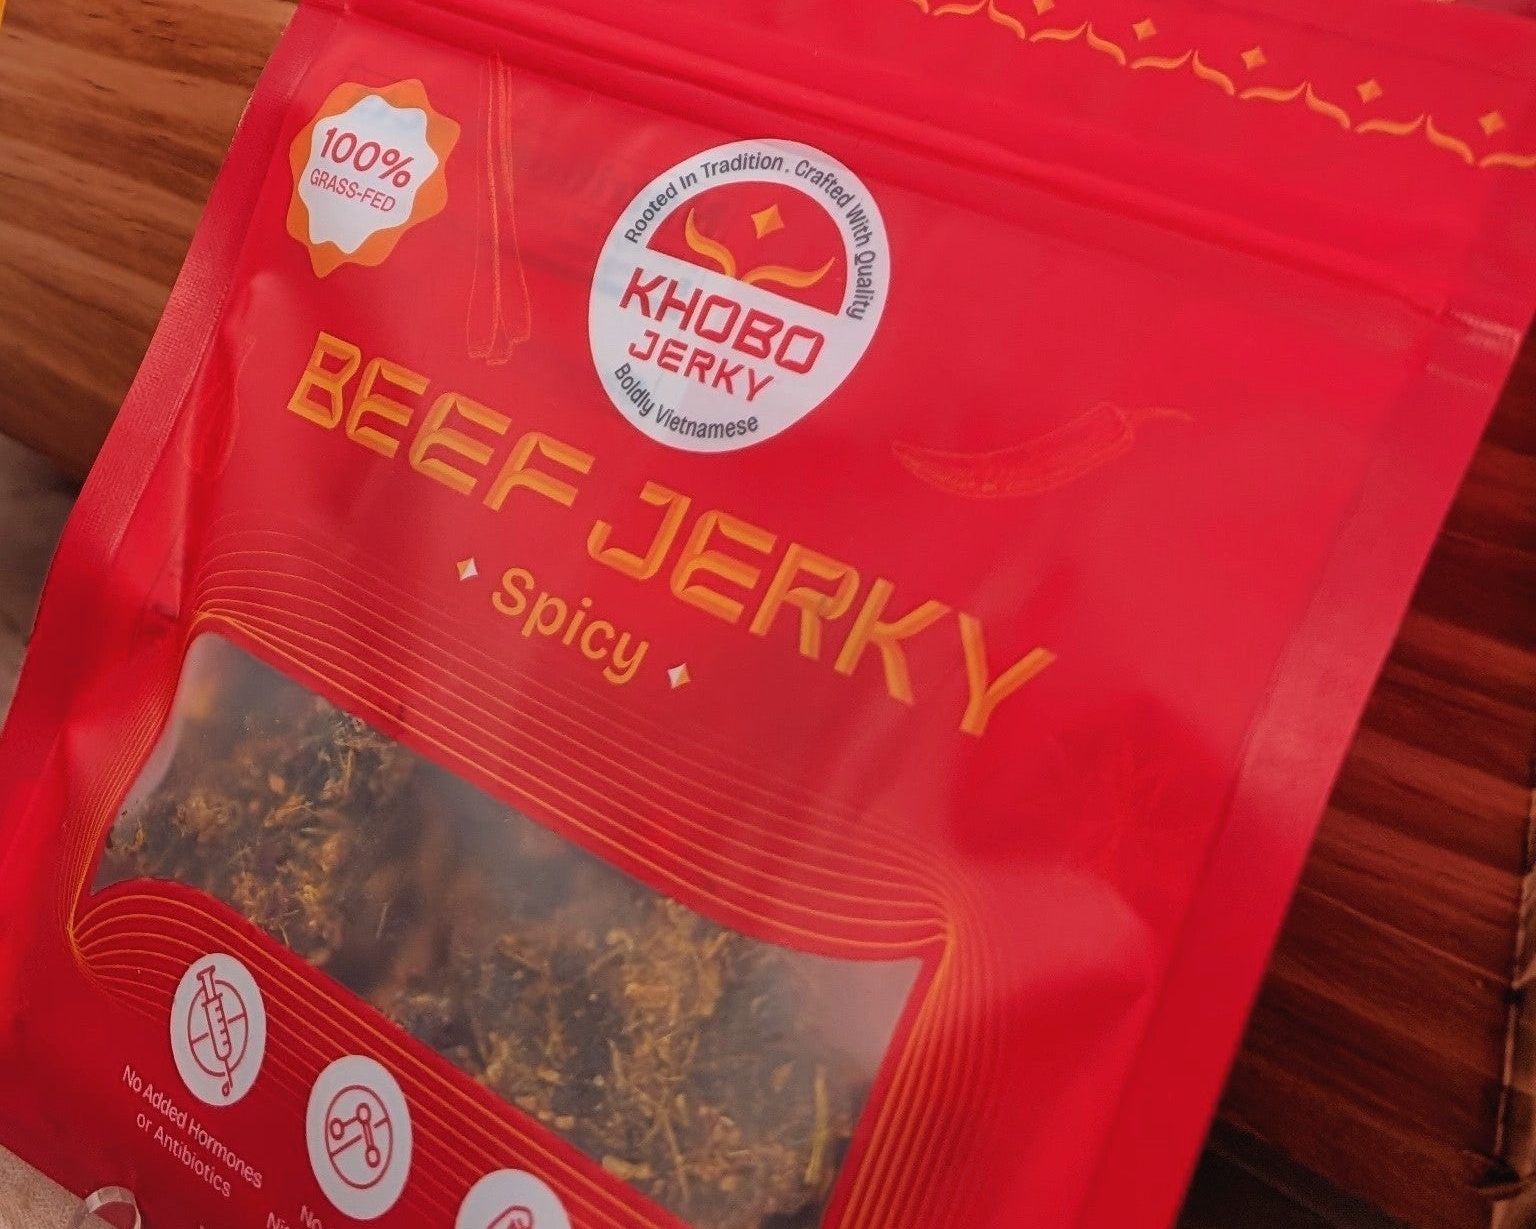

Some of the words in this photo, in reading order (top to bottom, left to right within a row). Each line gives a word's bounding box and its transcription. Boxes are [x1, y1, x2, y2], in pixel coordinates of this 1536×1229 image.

[310, 168, 396, 212] GRASS-FED
[320, 127, 415, 188] 100%
[679, 171, 698, 190] In
[700, 152, 784, 179] Tradition
[795, 159, 854, 208] Crafted
[624, 182, 678, 244] Rooted
[845, 203, 870, 248] With
[619, 266, 825, 375] KHOBO
[845, 250, 876, 321] Quality
[614, 362, 654, 417] Boldly
[654, 404, 758, 439] Vietnamese
[628, 329, 774, 402] JERKY
[286, 331, 596, 512] BEEF
[587, 480, 1058, 738] JERKY
[491, 567, 649, 685] Spicy
[122, 1064, 142, 1092] No
[142, 1083, 188, 1129] Added
[187, 1117, 262, 1189] Hormones
[136, 1113, 152, 1133] or
[154, 1125, 231, 1198] Antibiotics
